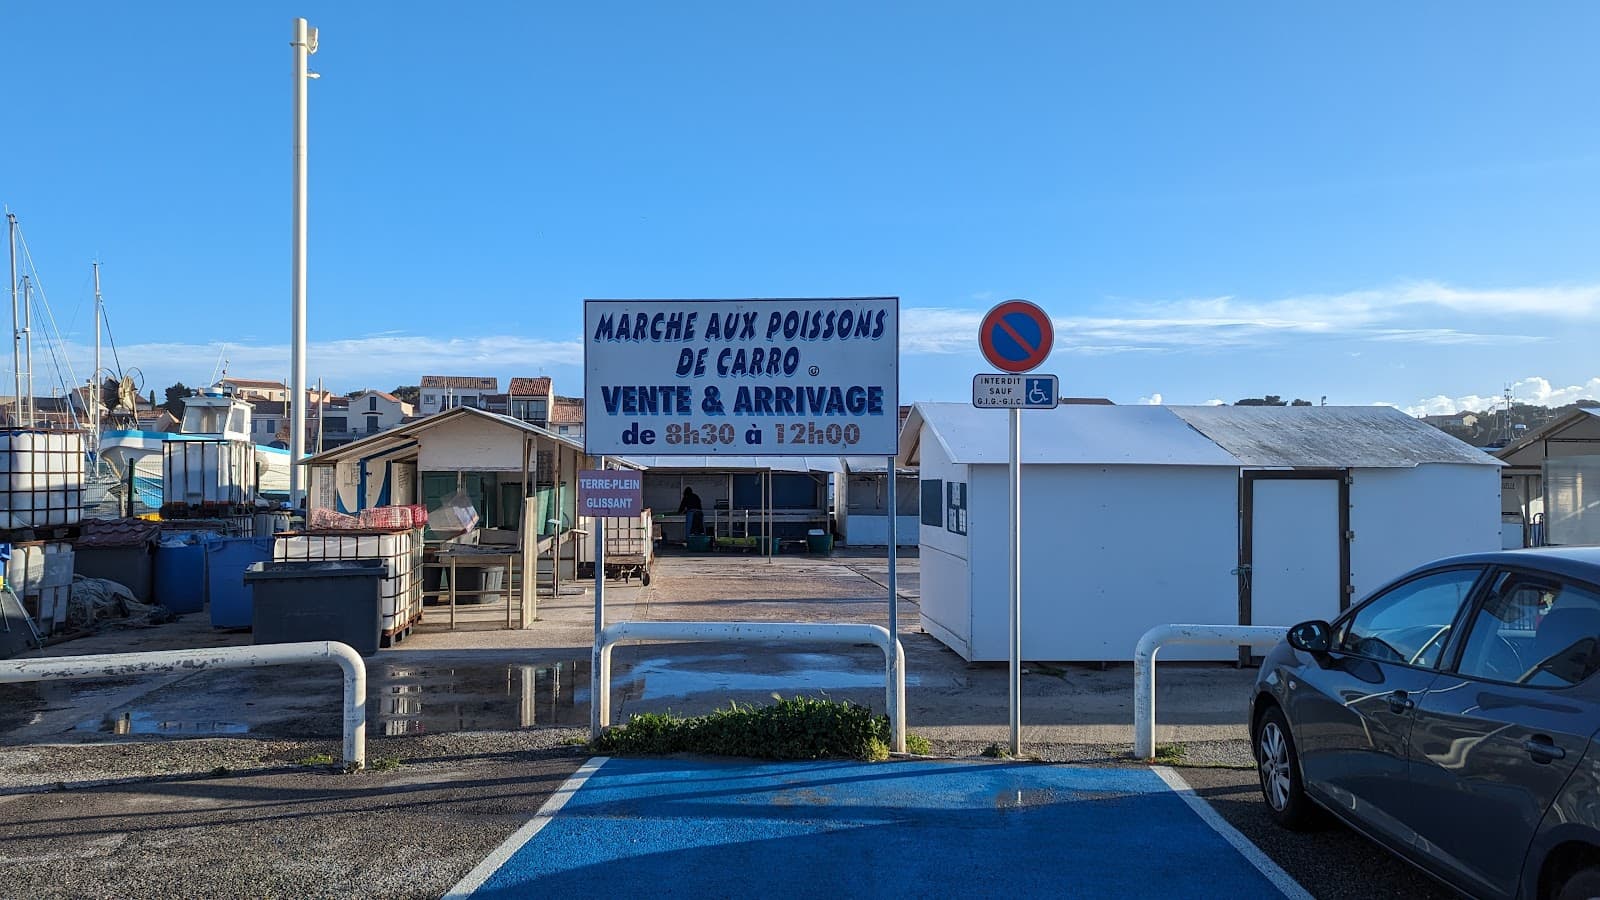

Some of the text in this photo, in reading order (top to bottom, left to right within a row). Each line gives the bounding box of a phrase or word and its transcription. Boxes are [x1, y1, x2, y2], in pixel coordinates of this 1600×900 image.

[594, 308, 888, 342] MARCHE AUX POISSONS
[676, 346, 800, 377] DE CARRO
[980, 377, 1021, 385] INTERDIT
[989, 387, 1013, 395] SAUF
[601, 386, 883, 416] VENTE & ARRIVAGE
[621, 422, 861, 445] de 8h30 à 12h00
[580, 479, 640, 490] TERRE-PLEIN
[586, 497, 633, 509] GLISSANT
